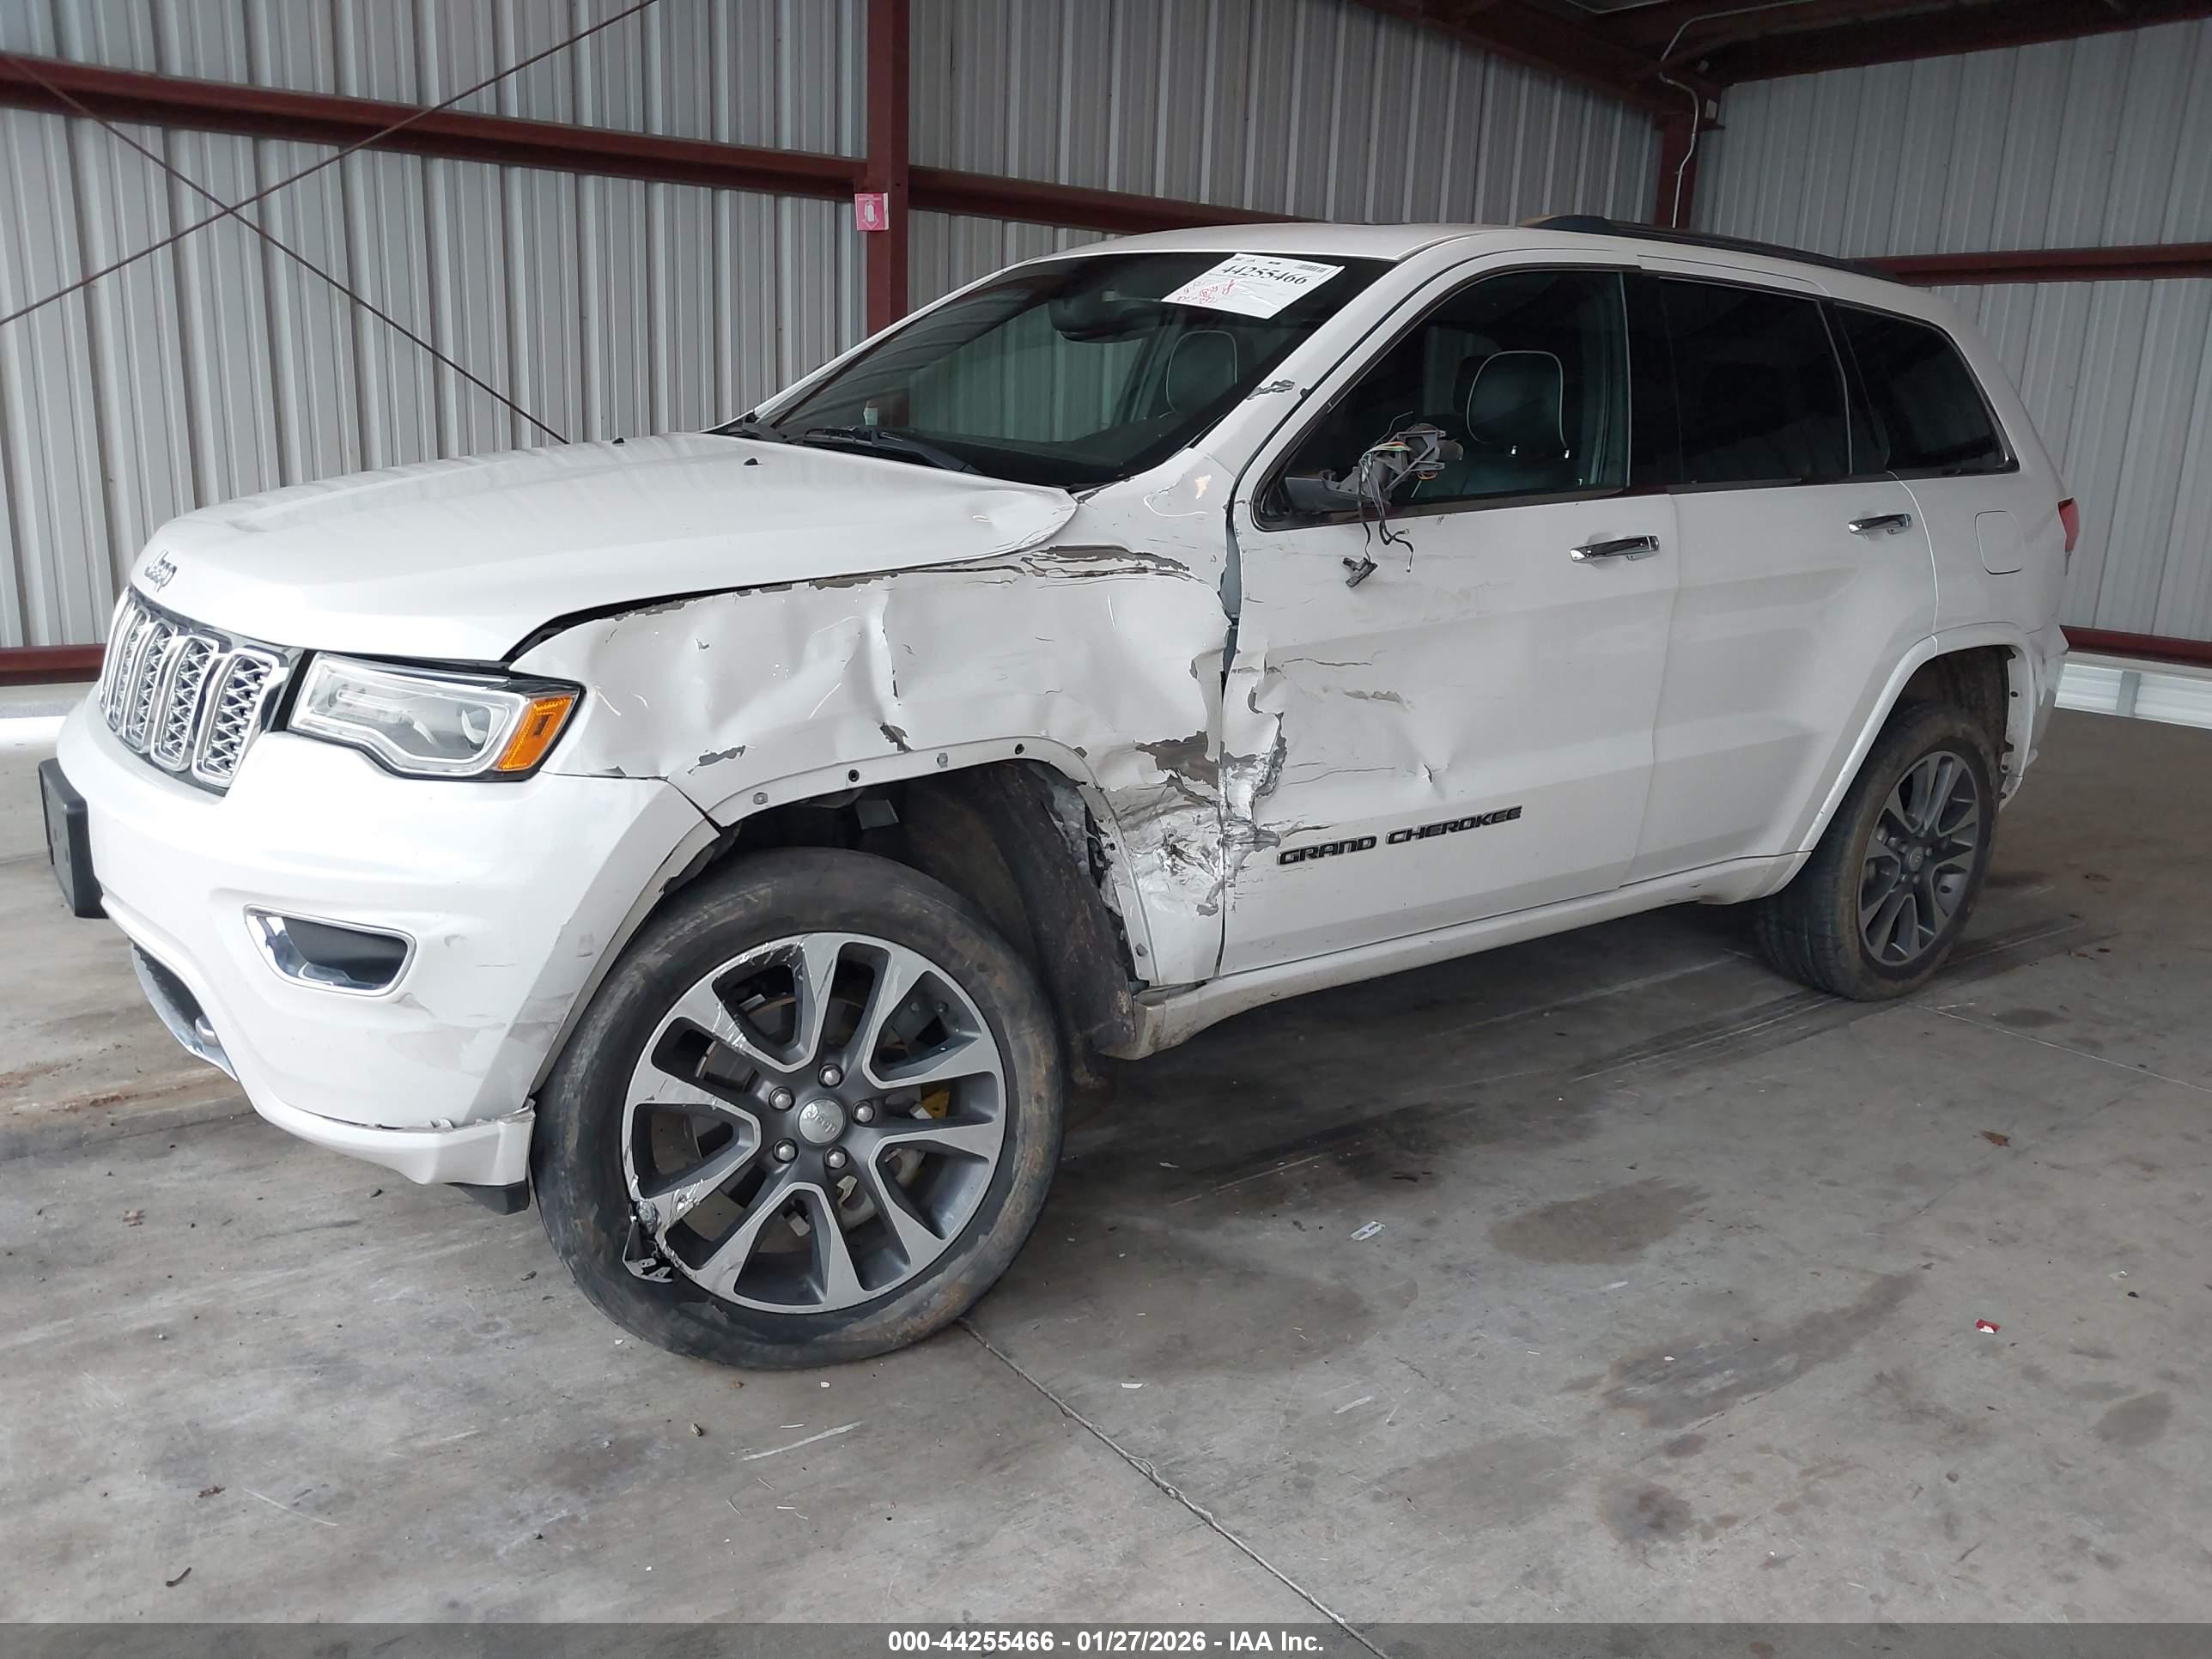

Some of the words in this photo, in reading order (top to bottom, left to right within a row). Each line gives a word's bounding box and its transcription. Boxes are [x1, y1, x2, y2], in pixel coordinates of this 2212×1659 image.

[1222, 264, 1311, 285] 44255466
[1277, 835, 1376, 866] GRAND
[1386, 805, 1522, 845] CHEROKEE
[806, 1104, 837, 1133] Jeep
